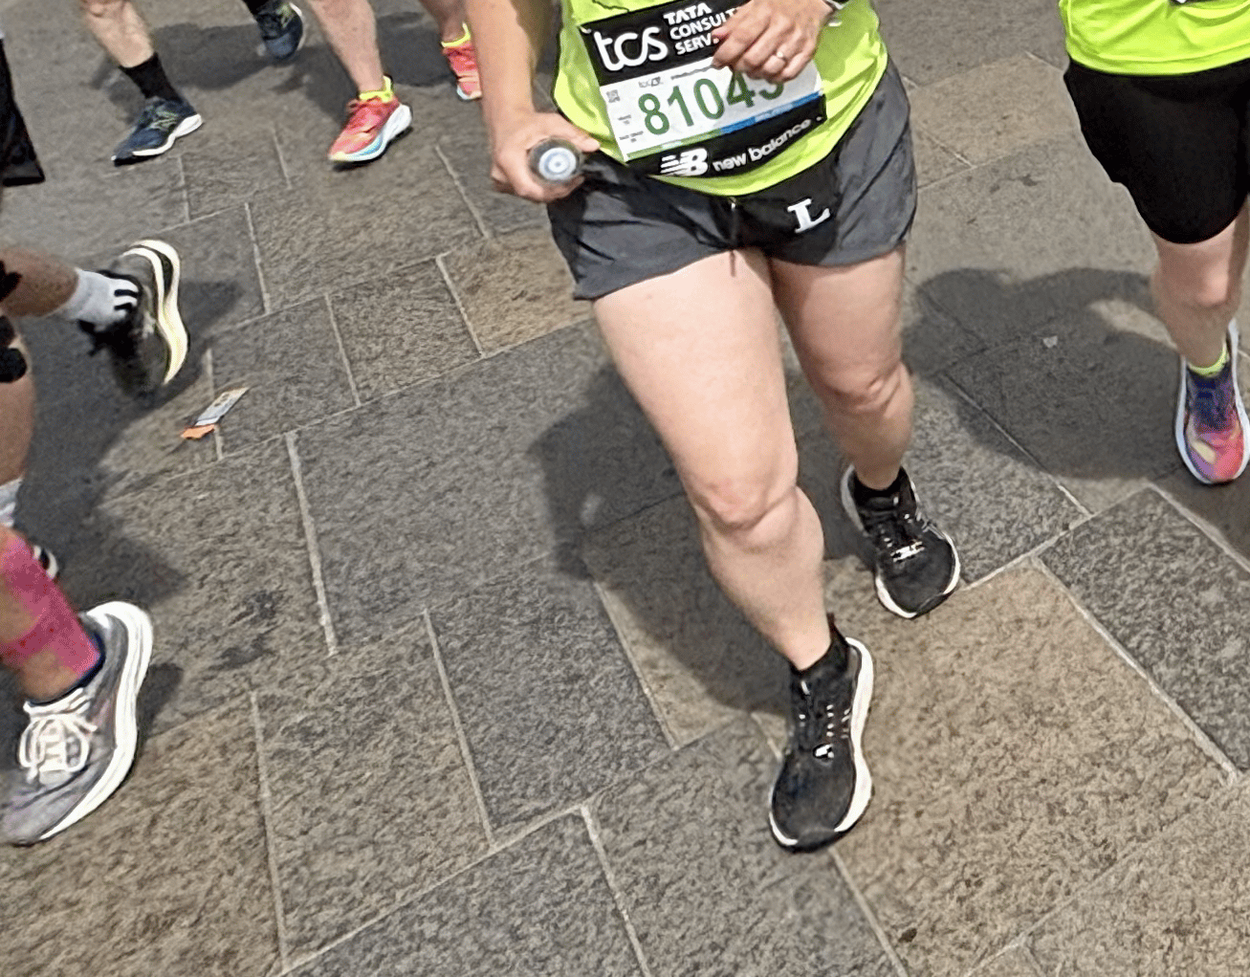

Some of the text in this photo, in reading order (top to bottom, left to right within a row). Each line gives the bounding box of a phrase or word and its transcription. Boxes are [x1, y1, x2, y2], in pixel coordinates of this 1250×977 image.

[663, 2, 713, 25] TATA
[593, 26, 669, 72] tcs
[675, 32, 720, 55] SERV
[712, 118, 812, 173] new balance
[787, 198, 831, 234] L
